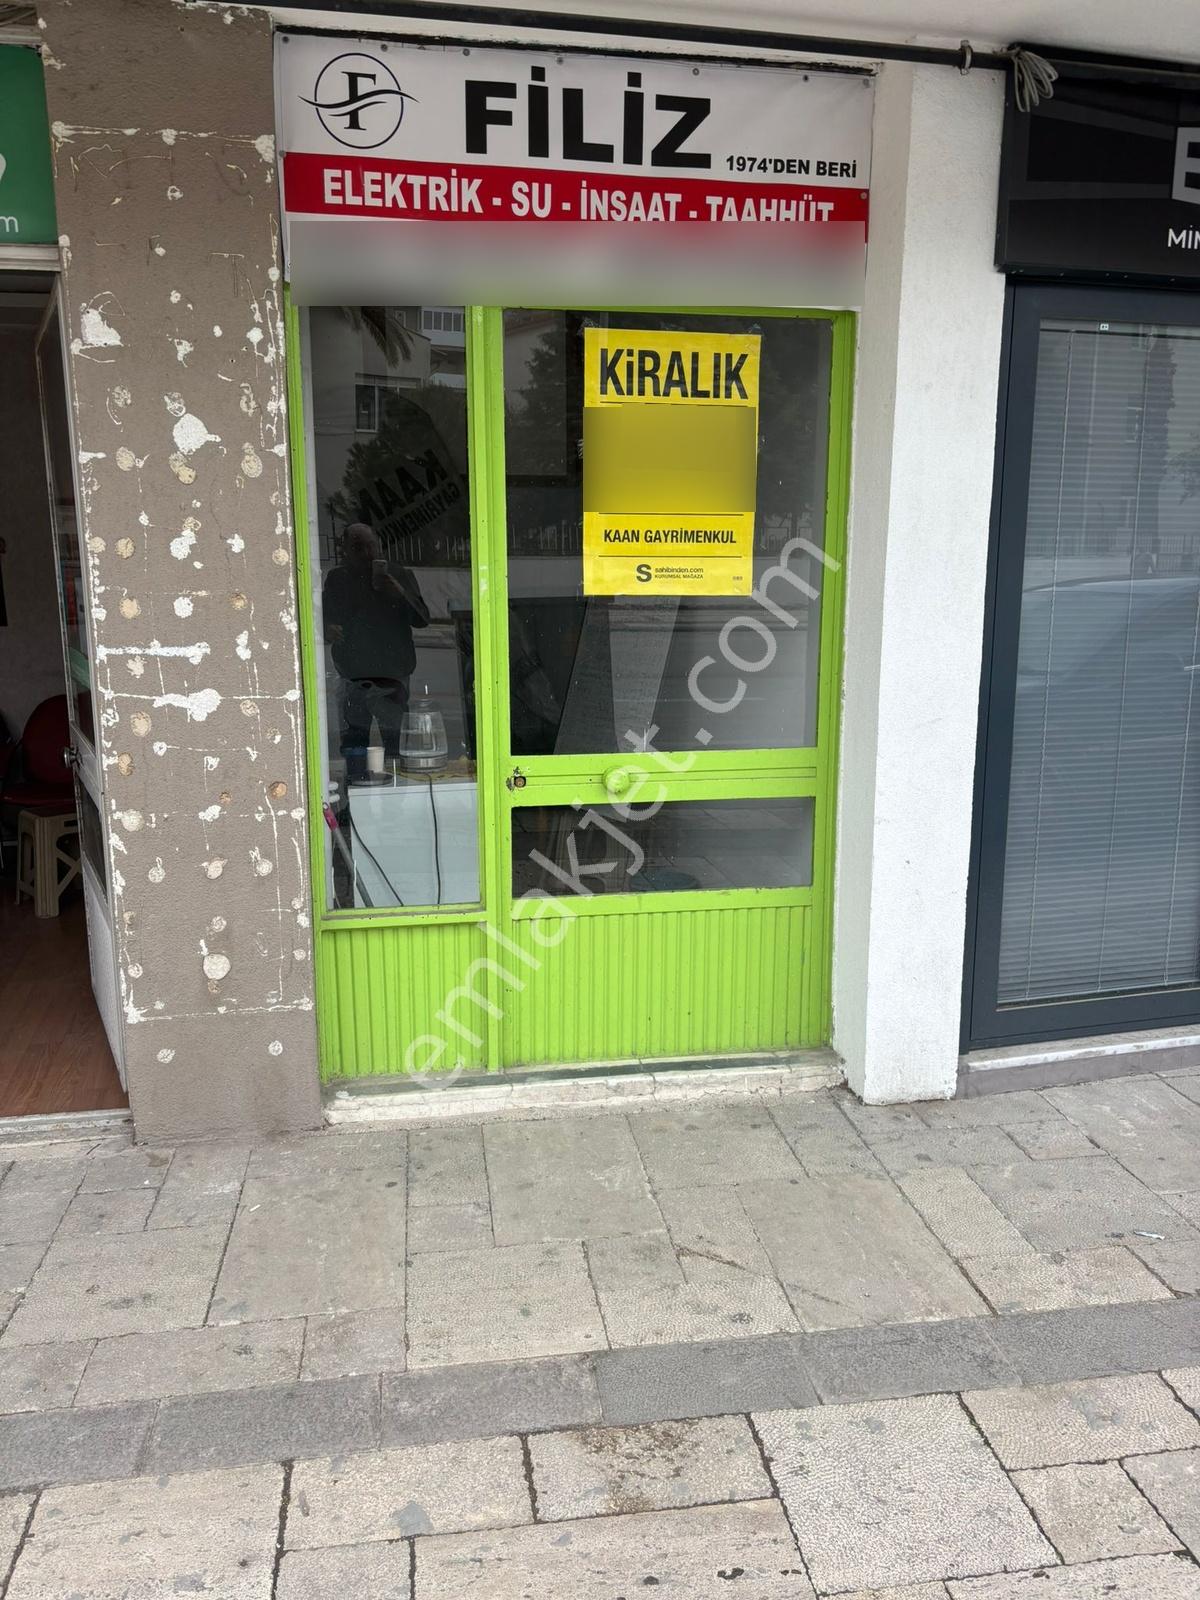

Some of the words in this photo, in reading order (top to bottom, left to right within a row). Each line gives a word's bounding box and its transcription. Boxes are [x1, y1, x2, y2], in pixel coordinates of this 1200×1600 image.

[465, 66, 711, 169] FİLİZ
[726, 155, 810, 175] 1974'DEN
[816, 160, 857, 178] BERİ
[323, 168, 484, 214] ELEKTRİK
[511, 180, 552, 218] SU
[705, 194, 834, 222] TAAHHÜT
[604, 529, 640, 543] KAAN
[644, 527, 737, 544] GAYRİMENKUL
[655, 566, 704, 574] sahibinden.com
